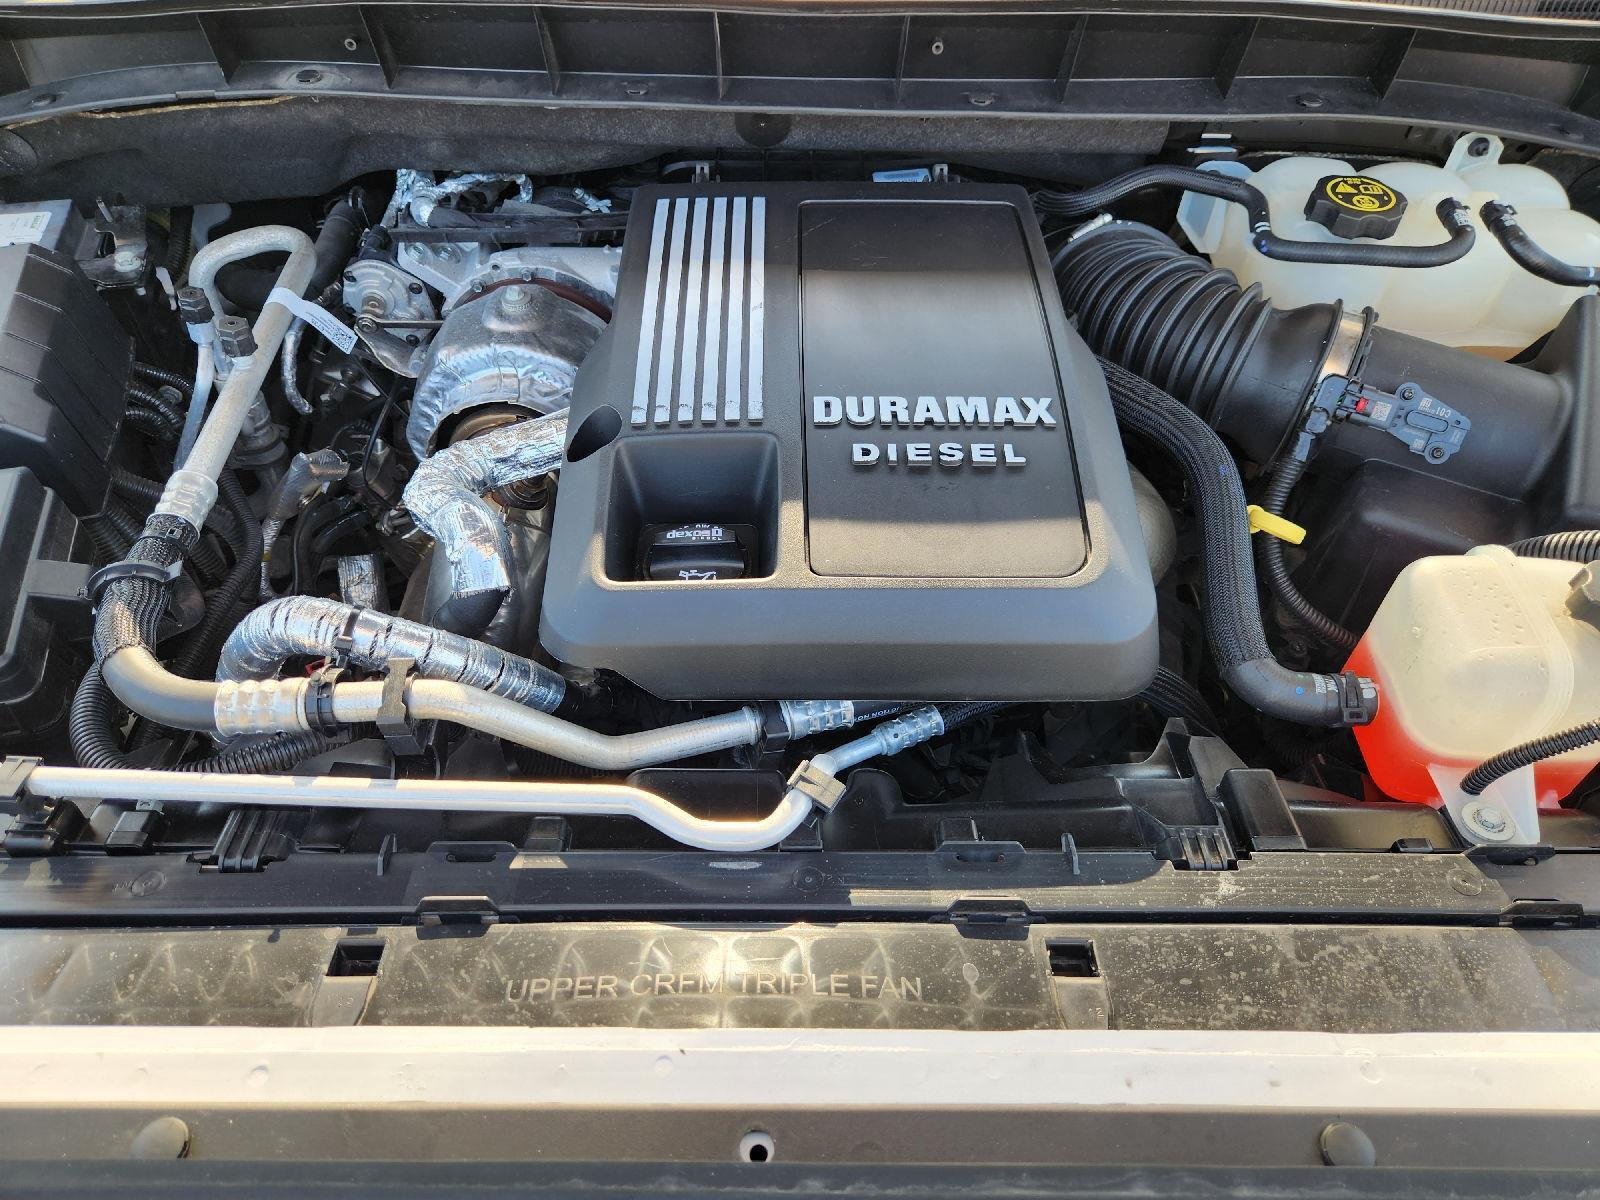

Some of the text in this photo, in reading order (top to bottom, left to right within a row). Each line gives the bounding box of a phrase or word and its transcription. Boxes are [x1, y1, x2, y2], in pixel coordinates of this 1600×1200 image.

[813, 396, 1056, 427] DURAMAX
[852, 442, 1027, 466] DIESEL
[504, 971, 922, 1002] UPPER CRFM TRIPLE FAN
